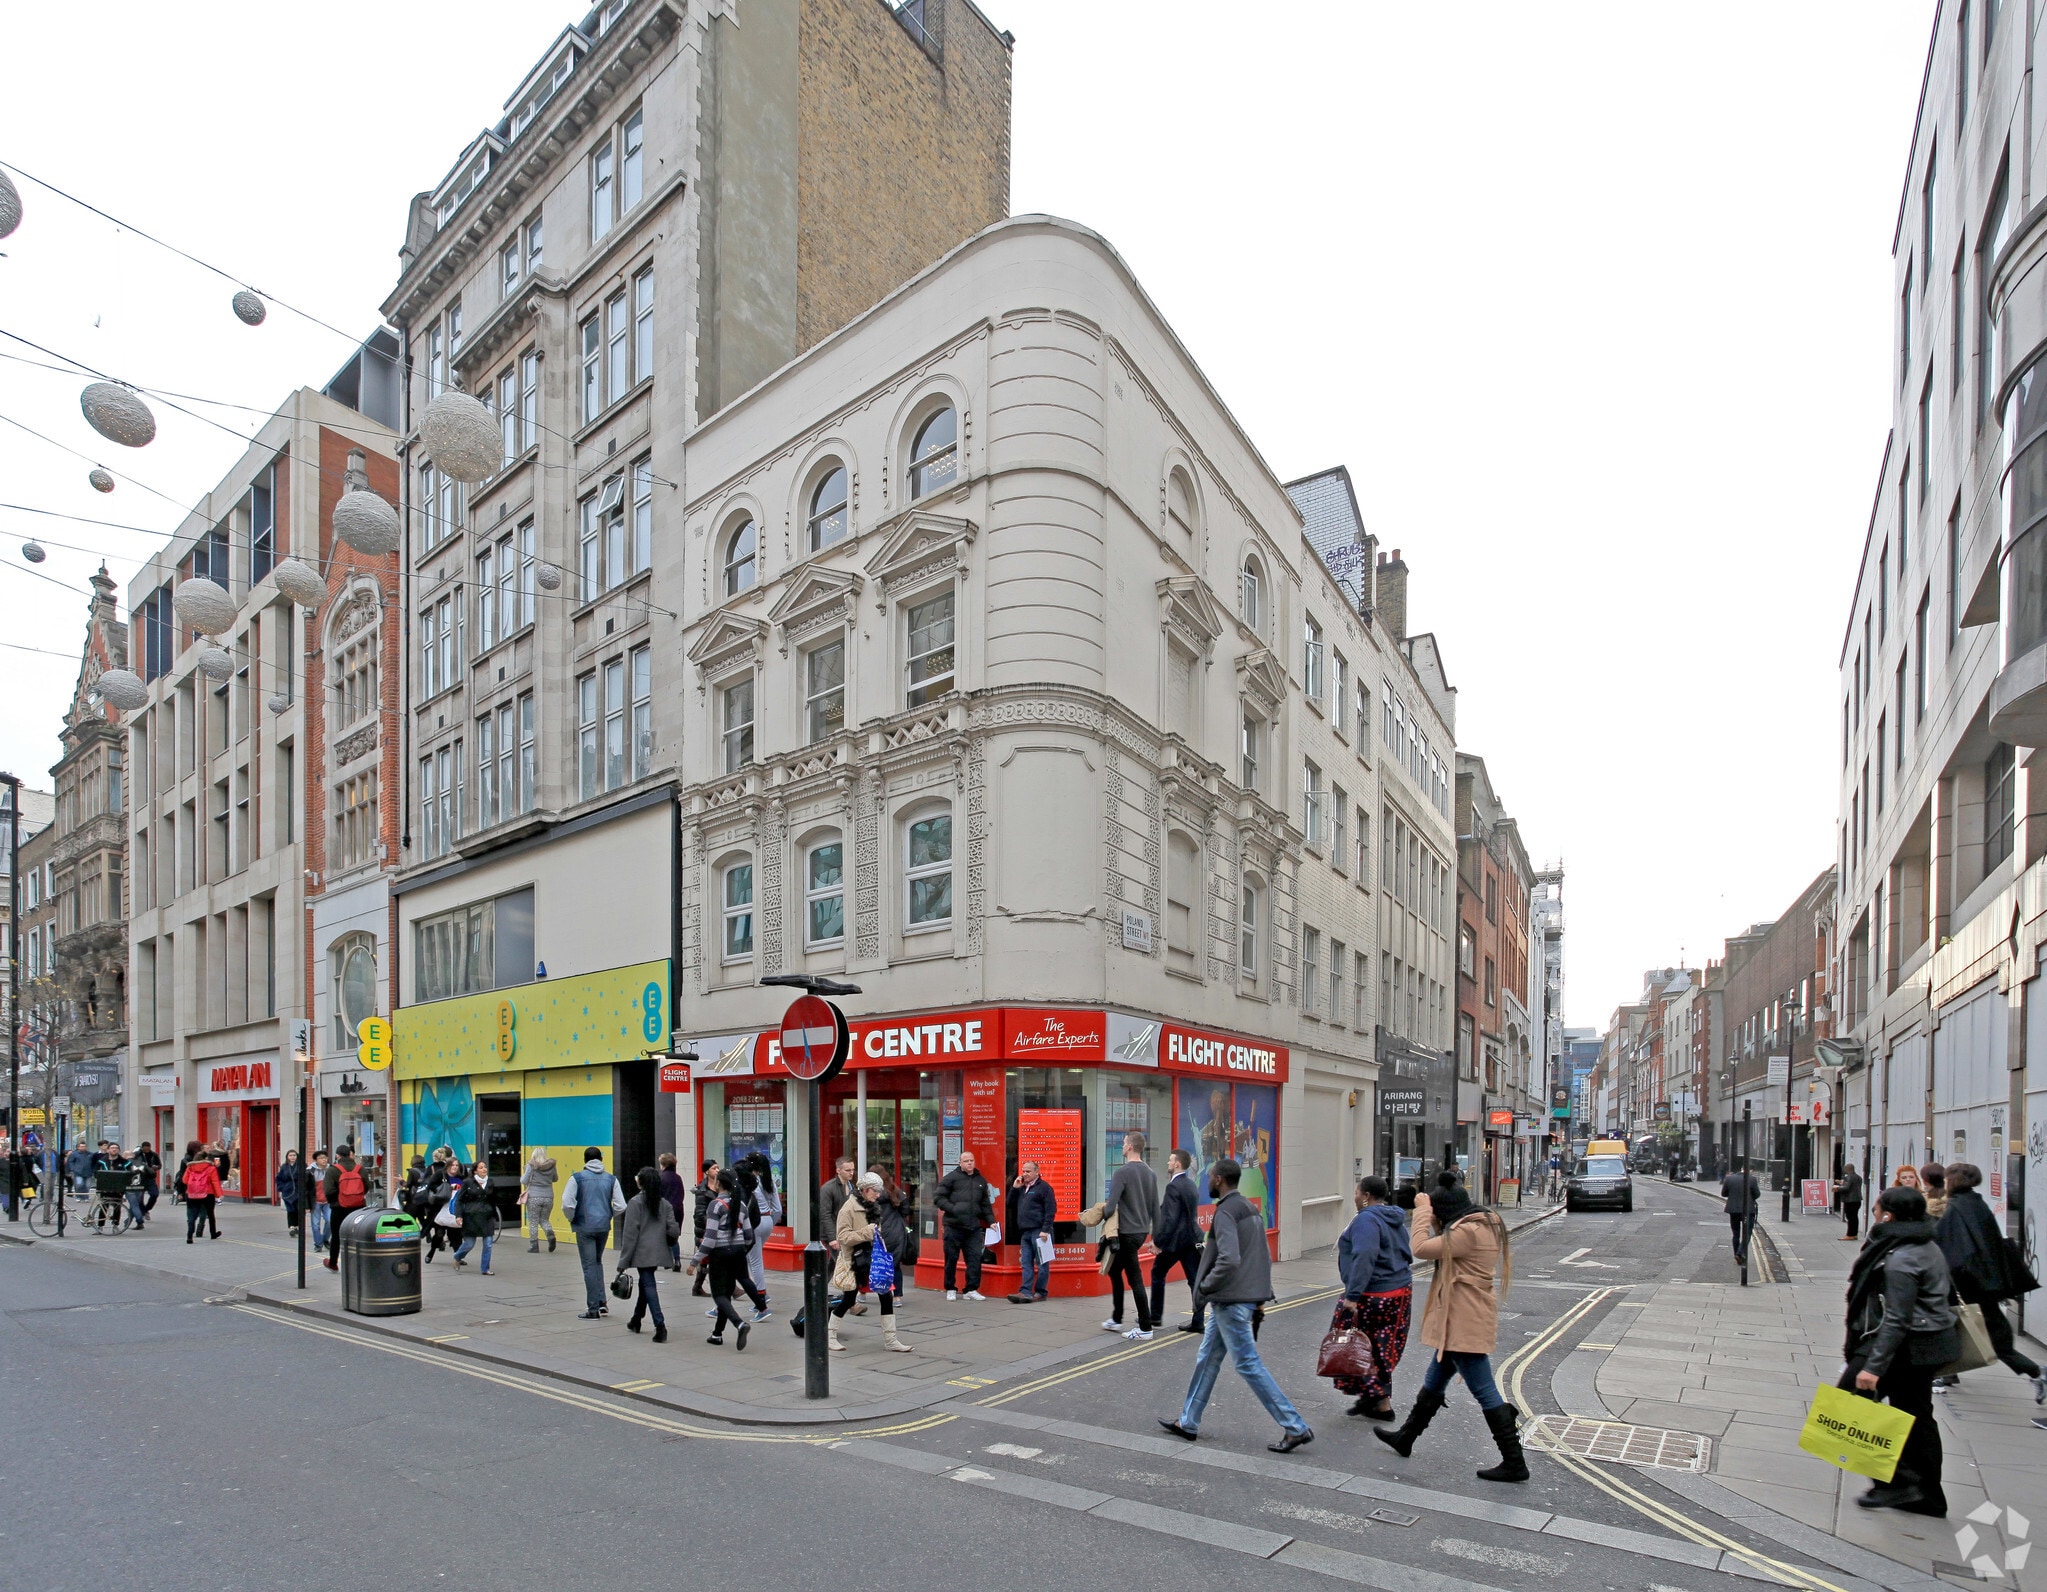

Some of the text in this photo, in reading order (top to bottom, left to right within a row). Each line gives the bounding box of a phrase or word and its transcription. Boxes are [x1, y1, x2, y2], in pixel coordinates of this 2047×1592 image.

[1126, 914, 1143, 928] POLAND
[1126, 926, 1142, 938] STREET
[1044, 1017, 1065, 1031] The
[864, 1021, 982, 1059] CENTRE
[1014, 1031, 1099, 1050] Airfare Experts
[1168, 1033, 1276, 1075] FLIGHT CENTRE
[211, 1061, 272, 1092] MATALAN
[1384, 1092, 1423, 1100] ARIRANG
[1384, 1103, 1421, 1114] 아리랑
[1817, 1413, 1892, 1450] SHOP ONLINE
